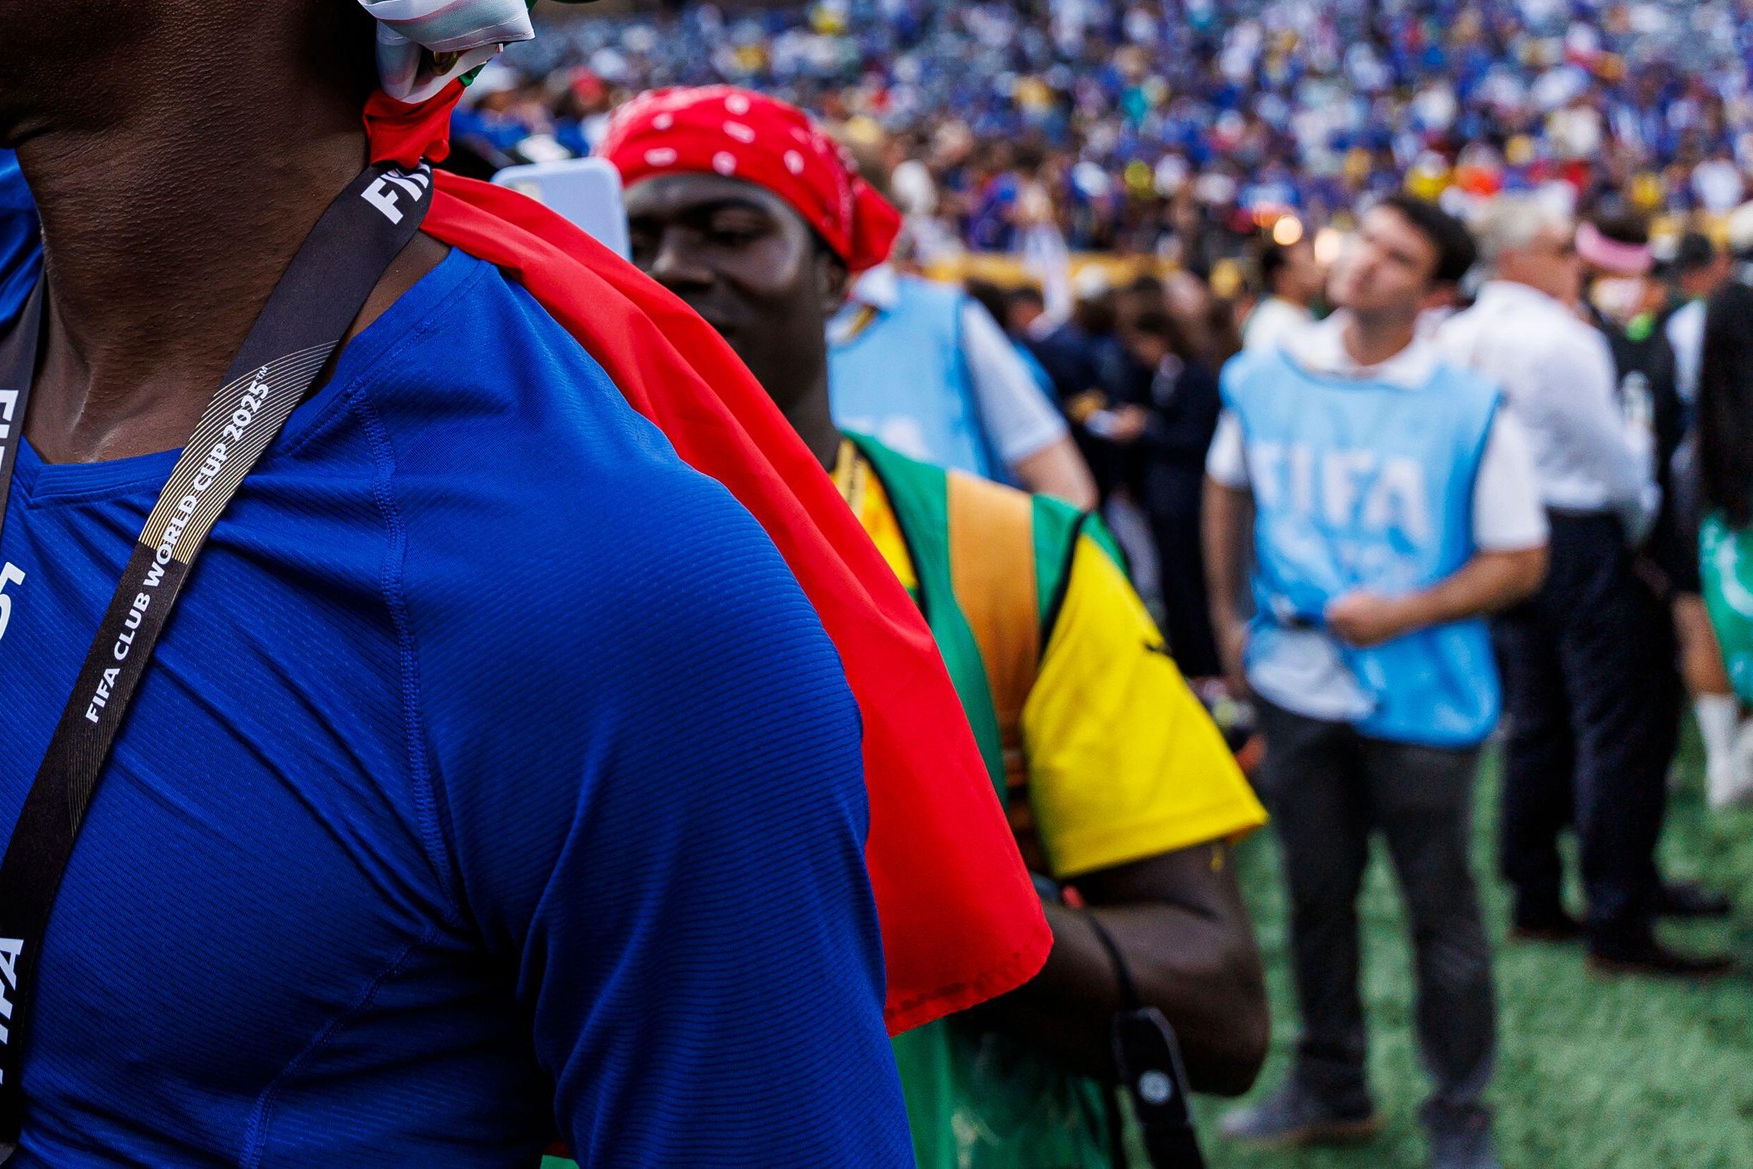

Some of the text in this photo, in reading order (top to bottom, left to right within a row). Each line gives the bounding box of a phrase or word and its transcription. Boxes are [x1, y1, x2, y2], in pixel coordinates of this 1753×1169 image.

[360, 155, 431, 225] FI
[1249, 443, 1433, 547] FIFA
[85, 667, 121, 723] FIFA
[113, 591, 151, 661] CLUB
[142, 494, 198, 588] WORLD
[193, 443, 228, 492] CUP
